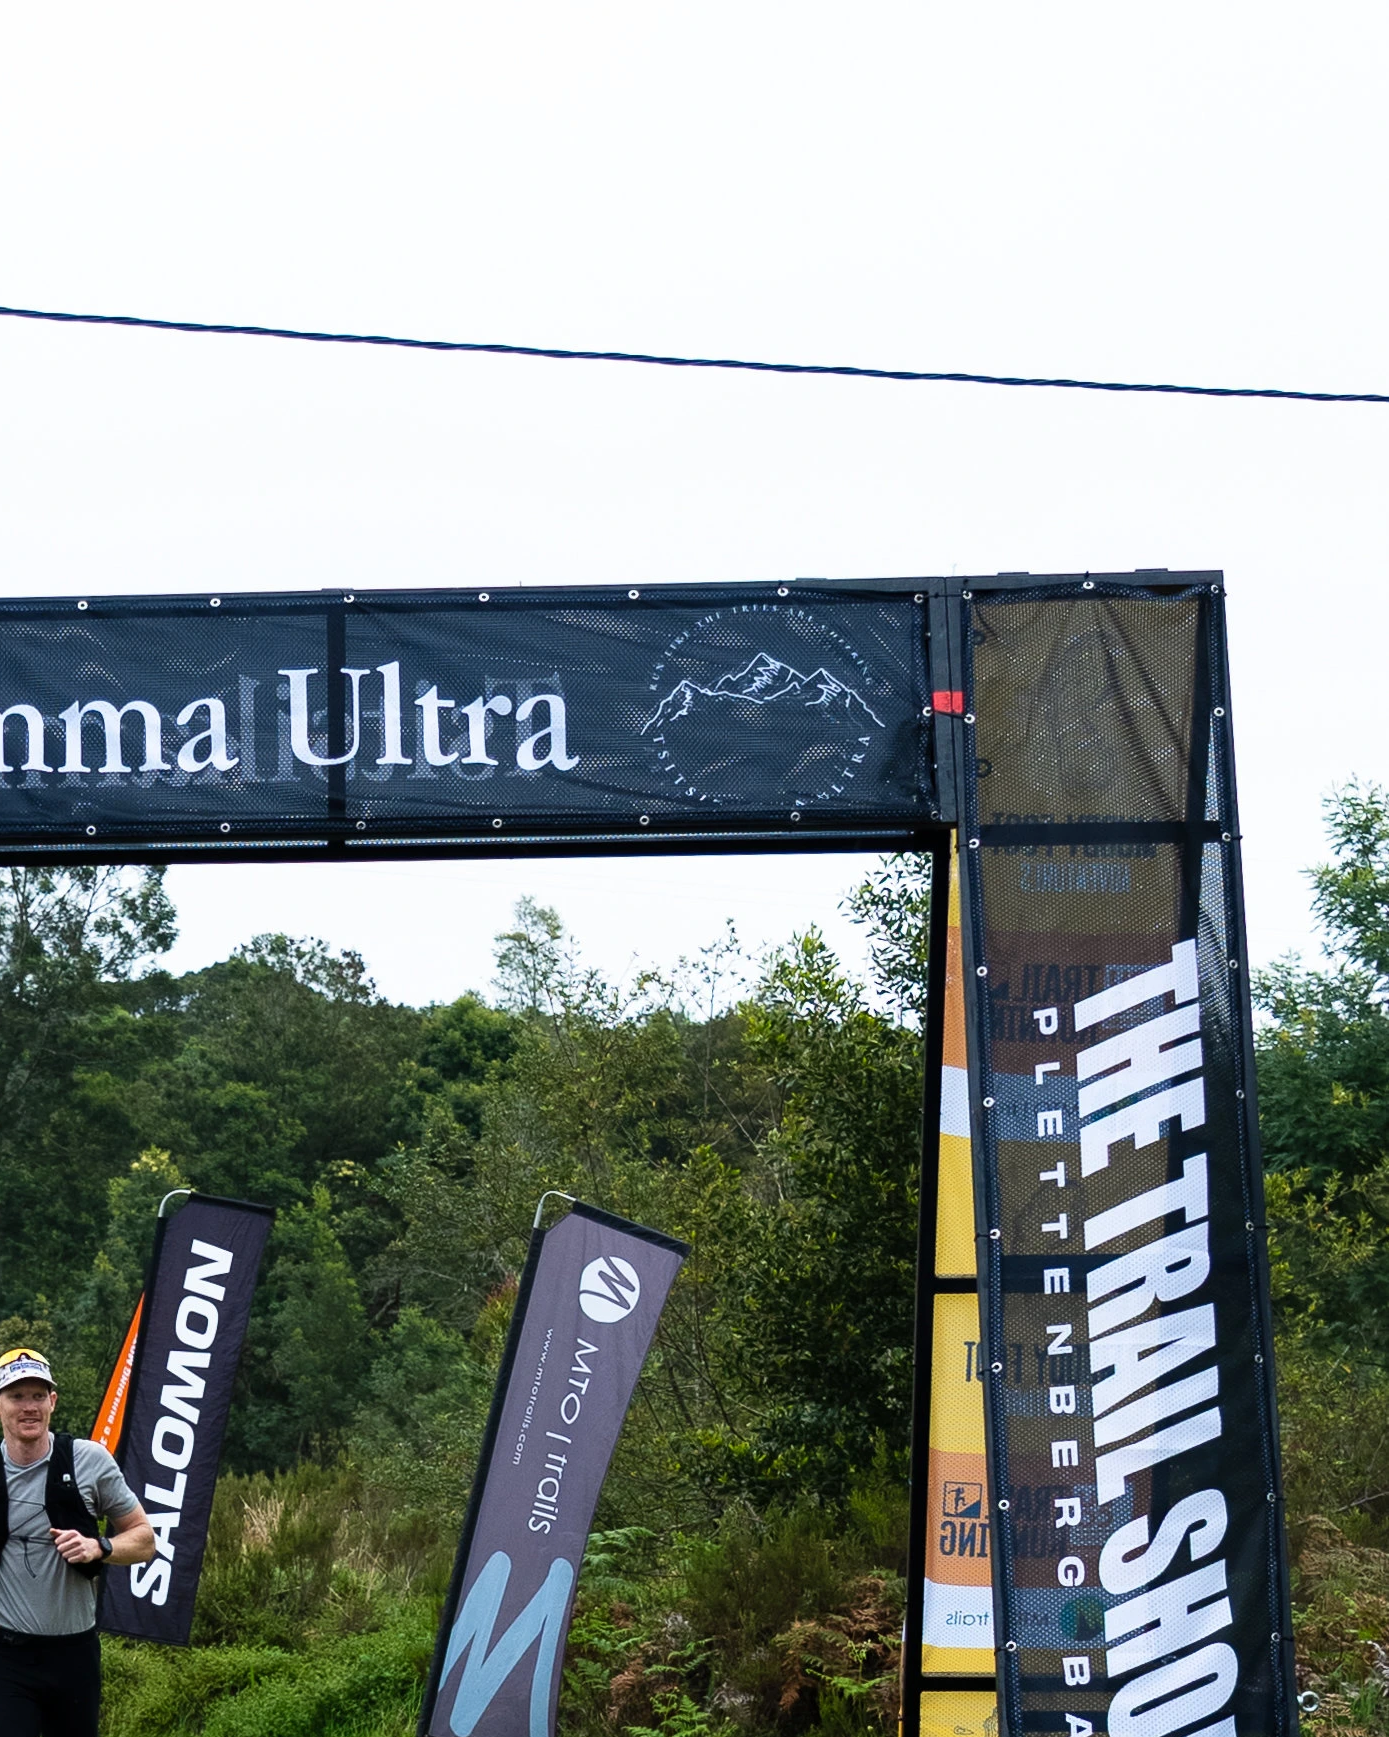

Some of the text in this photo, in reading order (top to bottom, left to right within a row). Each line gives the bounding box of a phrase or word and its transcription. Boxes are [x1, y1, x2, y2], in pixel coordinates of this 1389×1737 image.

[277, 660, 580, 772] Ultra
[1073, 938, 1206, 1178] THE
[559, 1337, 600, 1425] MTO
[1032, 1005, 1085, 1588] PLETTENBERG
[1084, 1152, 1223, 1505] TRAIL
[129, 1238, 234, 1606] SALOMON
[511, 1327, 554, 1466] www.mtotrails.com
[527, 1451, 569, 1535] trails
